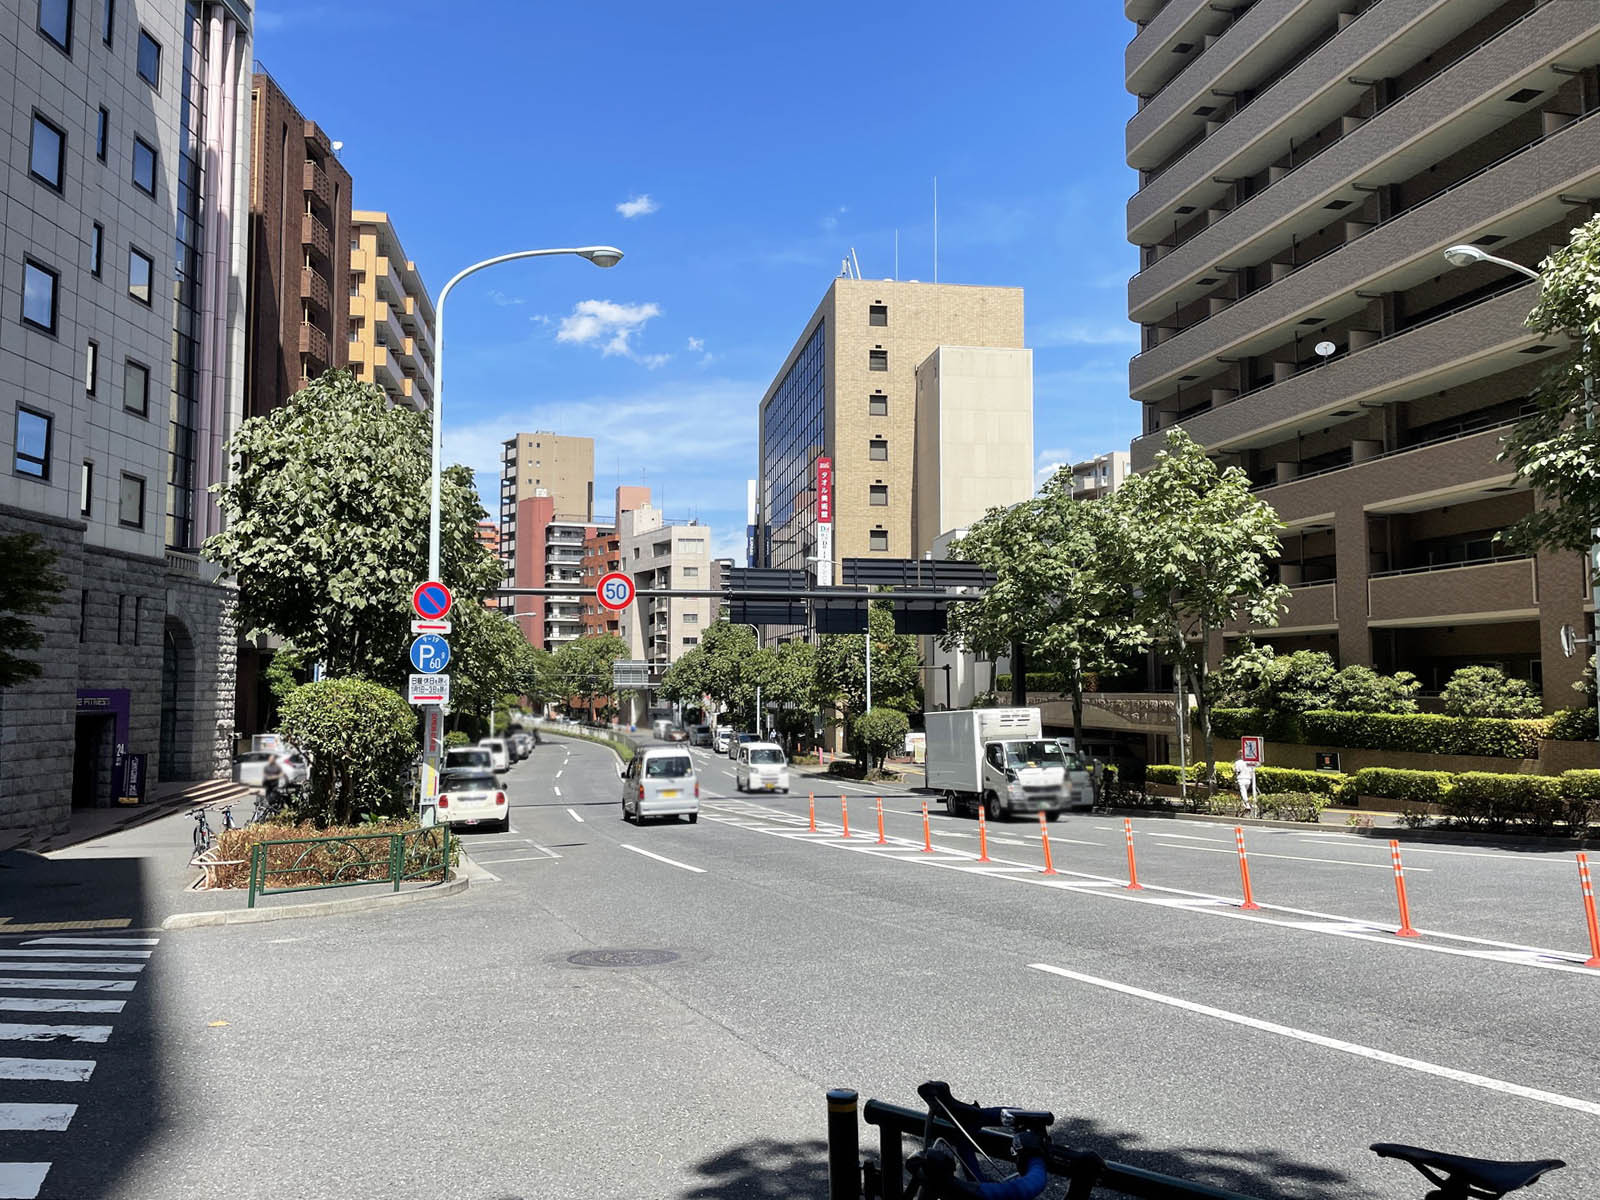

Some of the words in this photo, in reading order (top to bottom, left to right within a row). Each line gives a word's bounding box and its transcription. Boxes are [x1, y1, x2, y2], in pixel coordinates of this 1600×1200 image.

[606, 583, 626, 600] 50
[419, 644, 435, 669] P
[429, 657, 441, 669] 60
